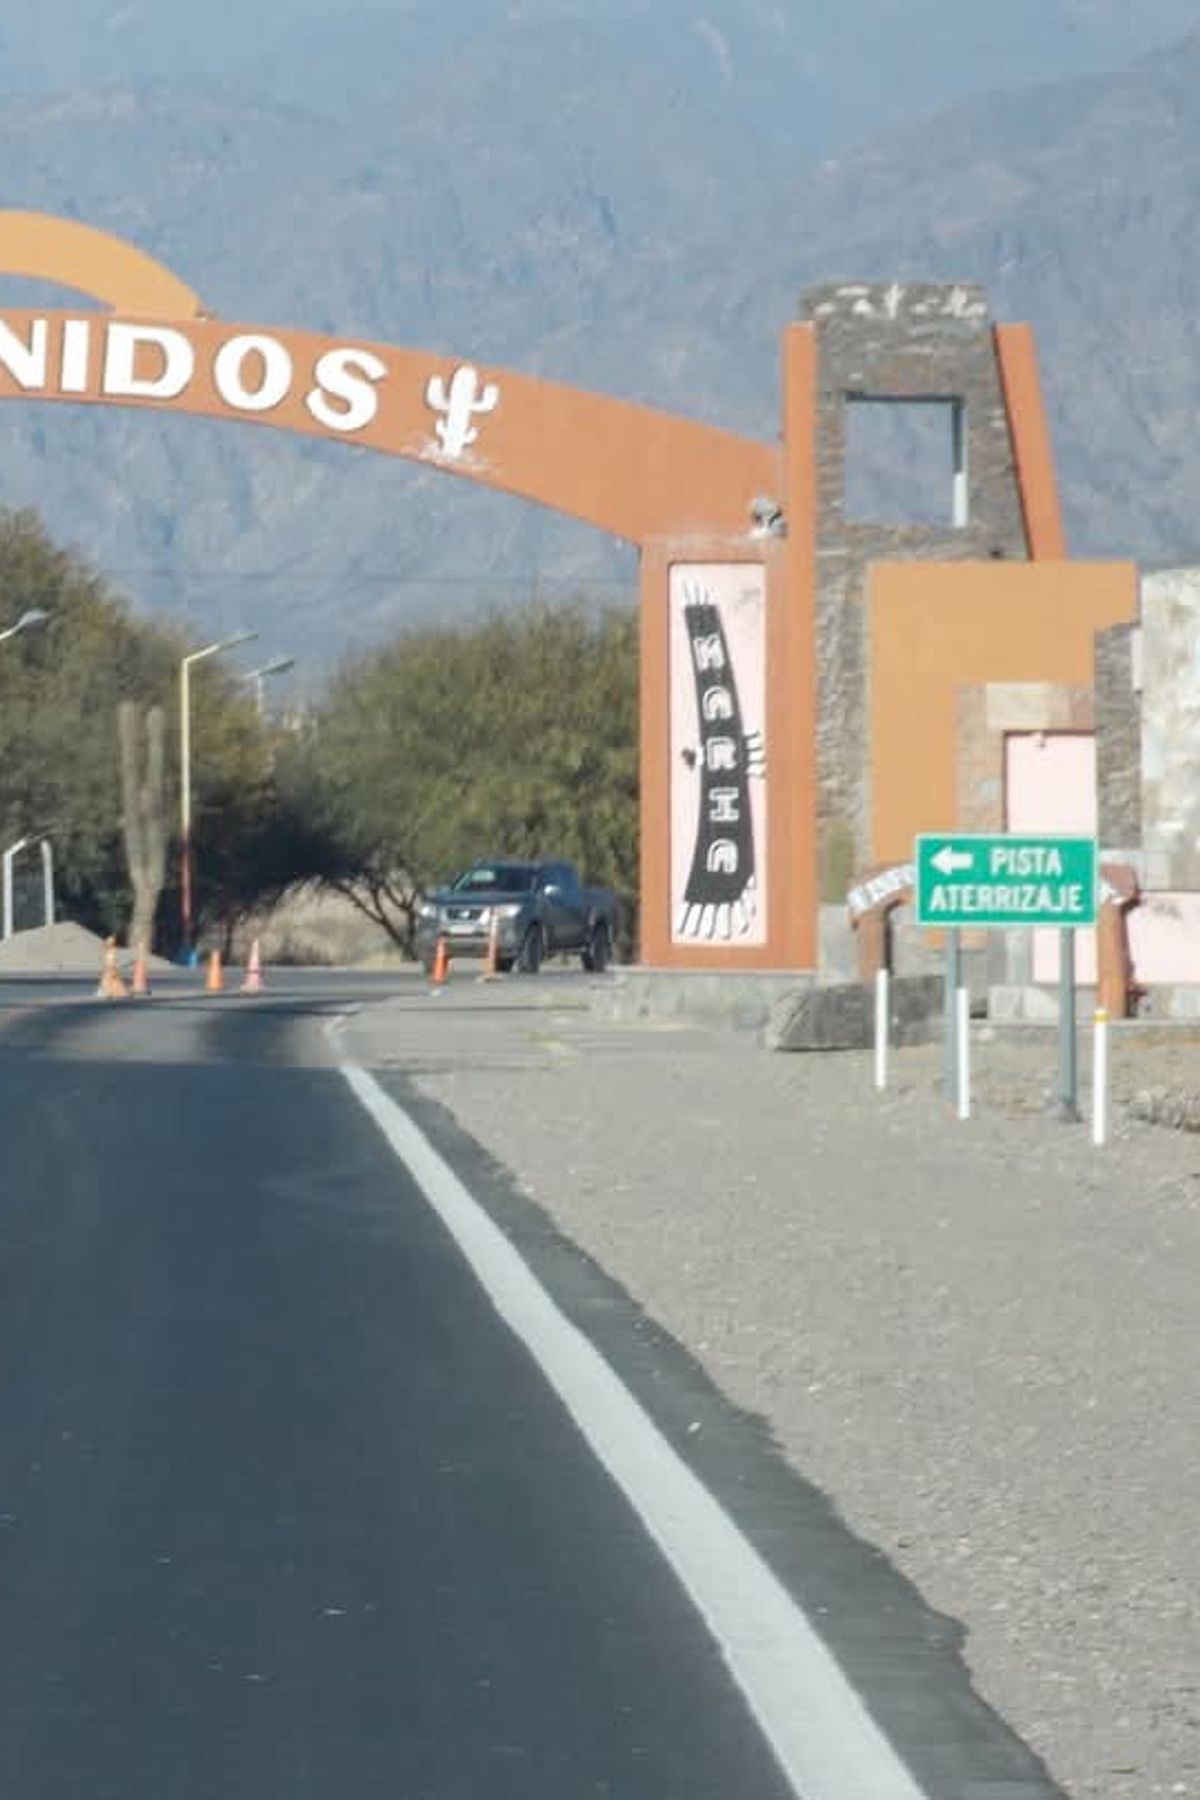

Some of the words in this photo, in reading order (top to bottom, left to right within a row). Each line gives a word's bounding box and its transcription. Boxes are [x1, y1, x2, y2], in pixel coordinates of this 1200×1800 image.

[693, 633, 740, 875] MARIA
[989, 847, 1063, 876] PISTA
[929, 882, 1085, 913] ATERRIZAJE
